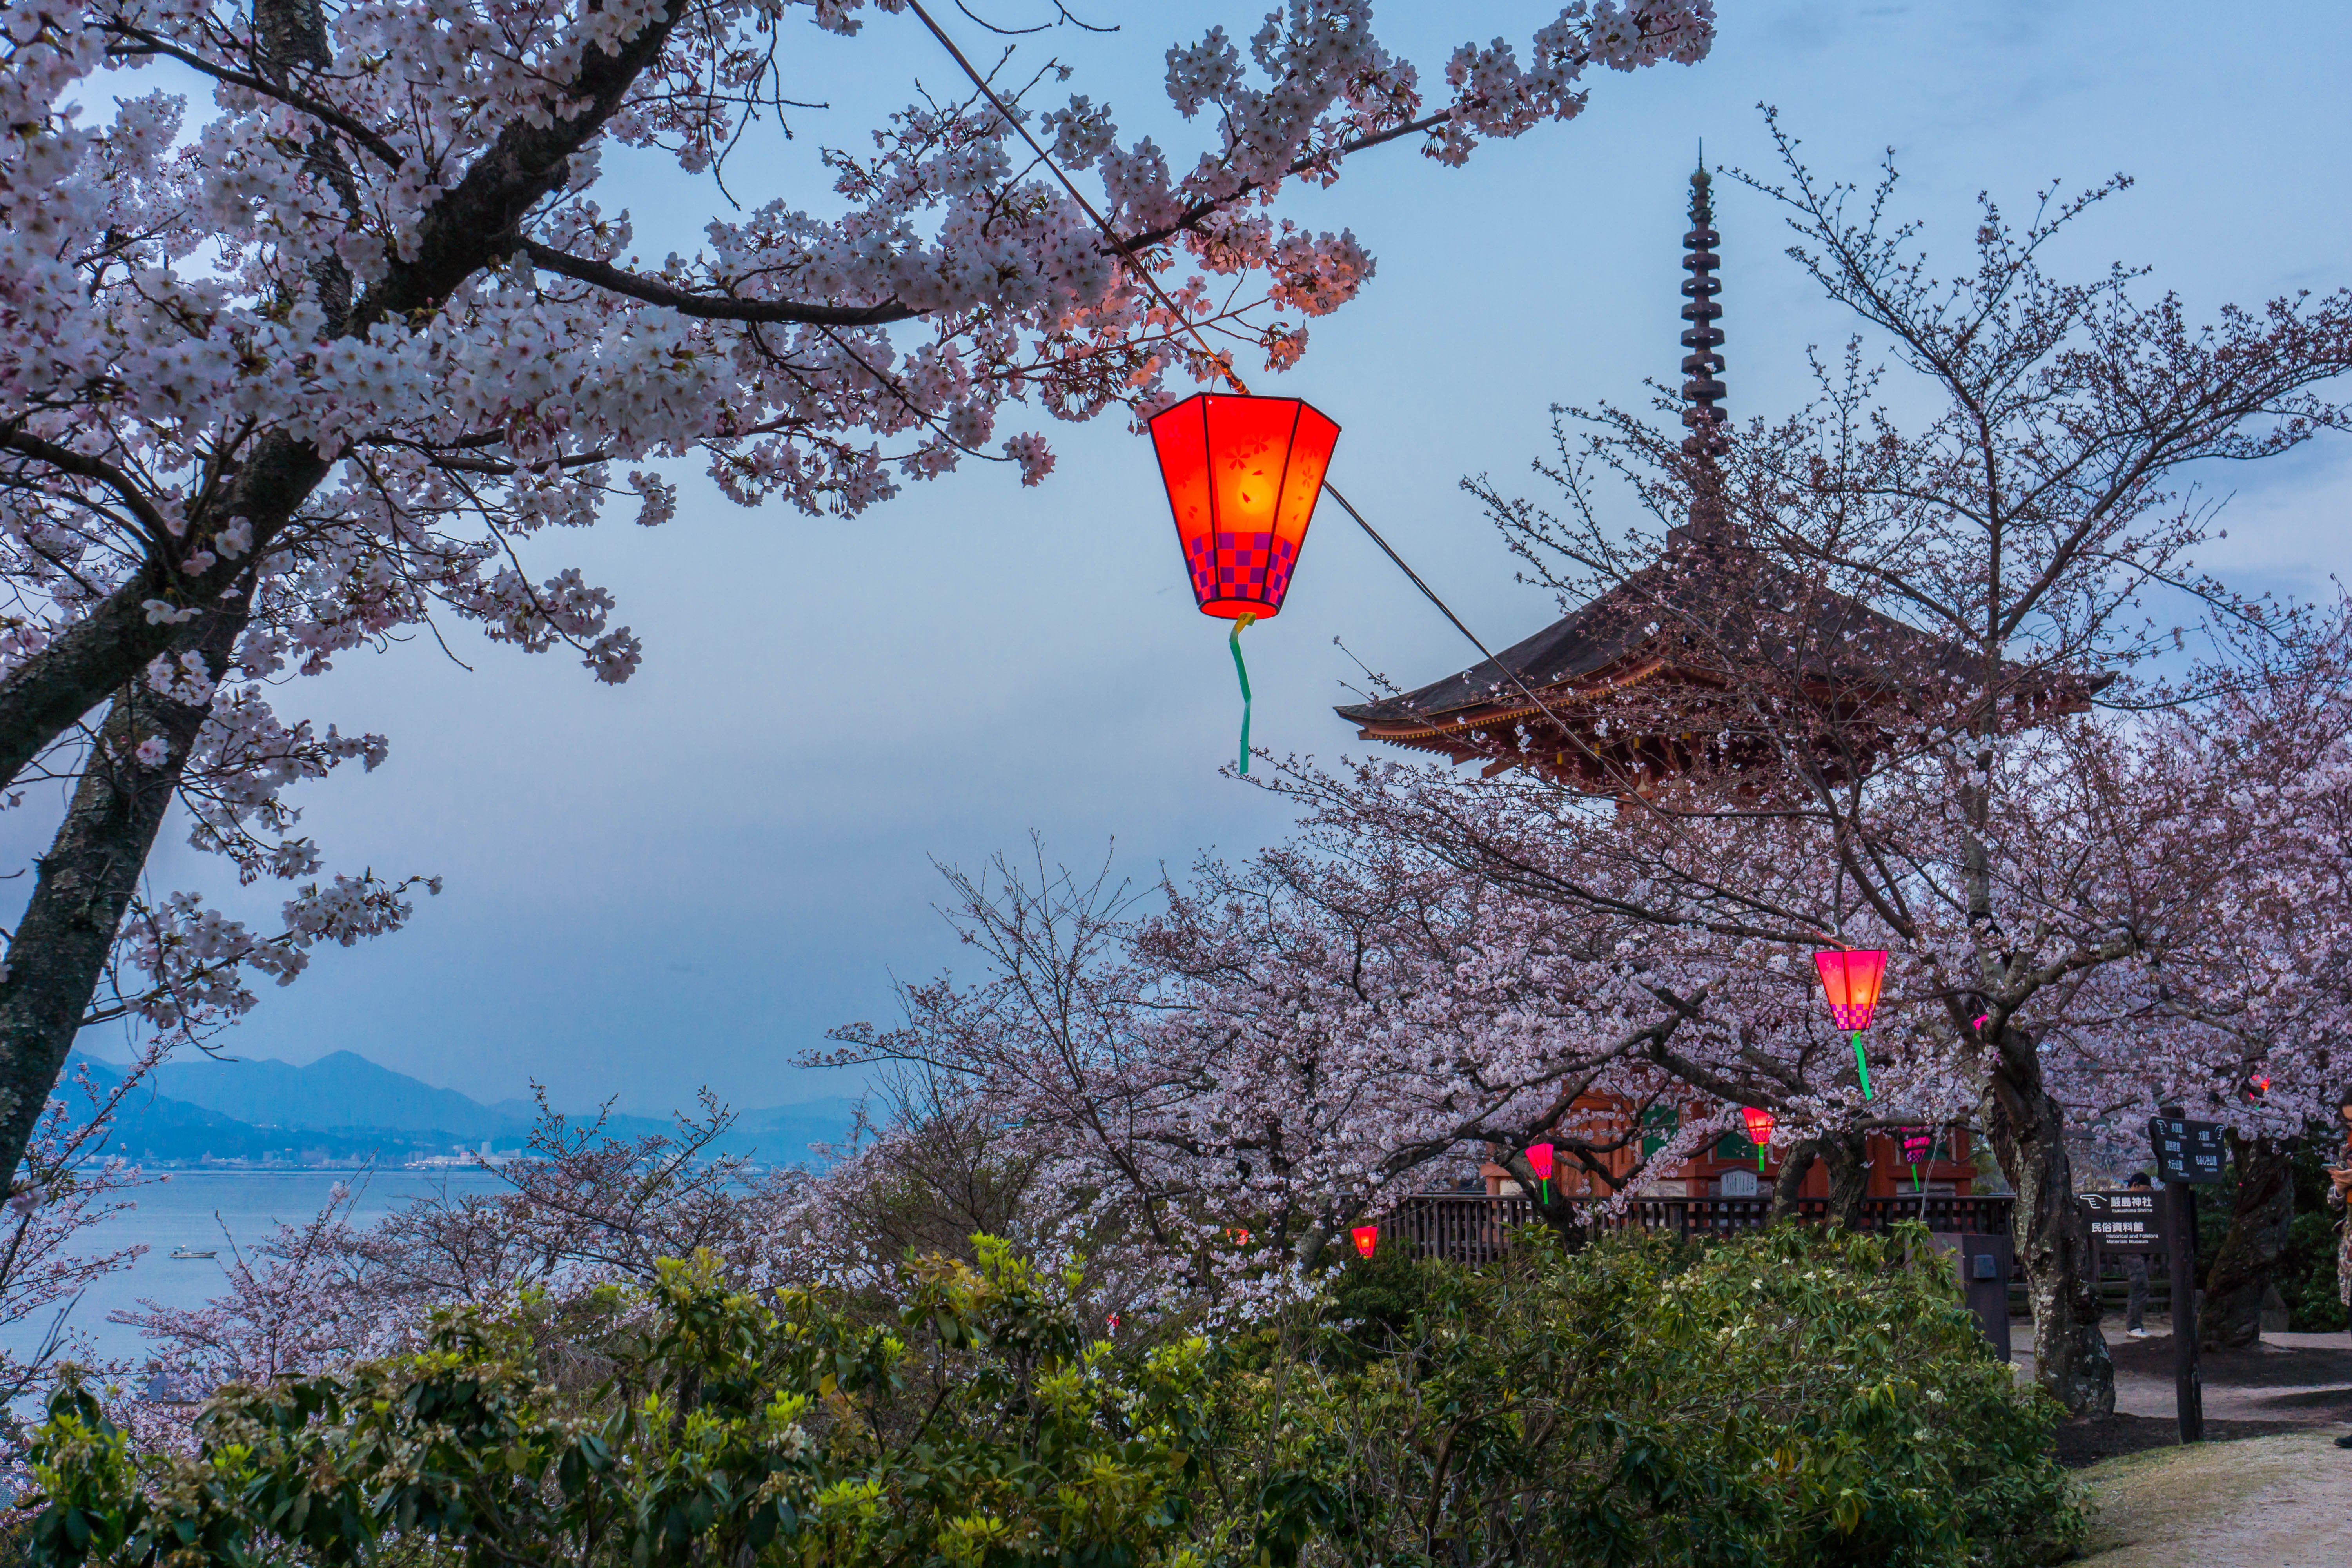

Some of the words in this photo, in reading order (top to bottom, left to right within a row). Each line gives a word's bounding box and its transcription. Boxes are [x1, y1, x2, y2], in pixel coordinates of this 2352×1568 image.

[2092, 1221, 2144, 1232] 民俗資料館
